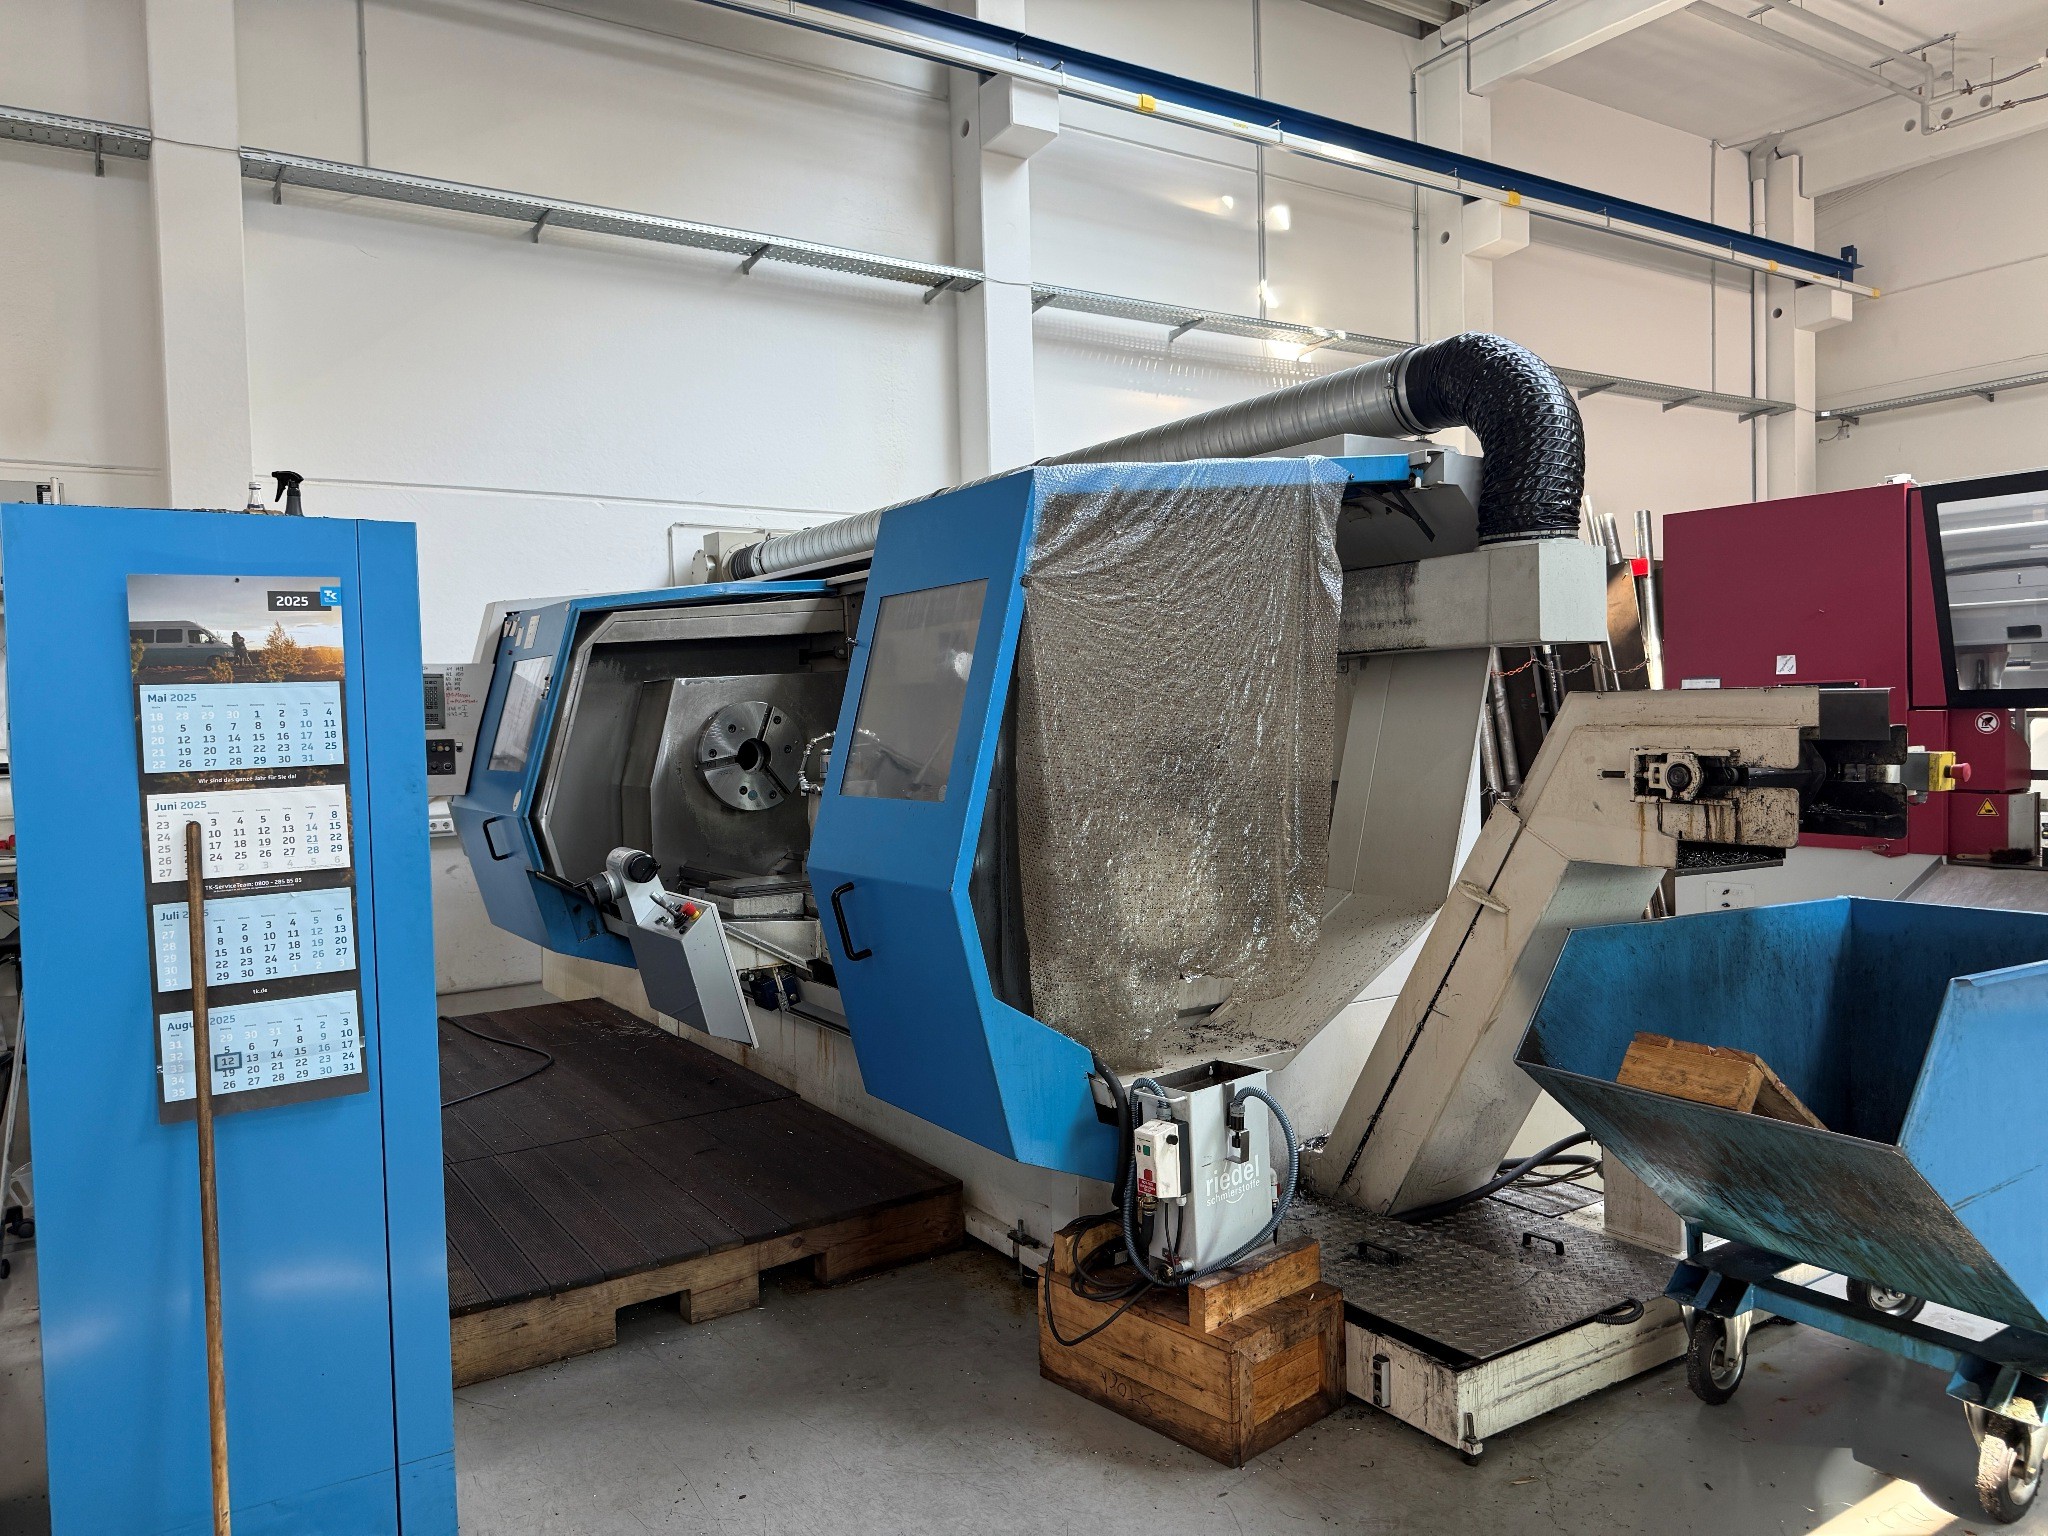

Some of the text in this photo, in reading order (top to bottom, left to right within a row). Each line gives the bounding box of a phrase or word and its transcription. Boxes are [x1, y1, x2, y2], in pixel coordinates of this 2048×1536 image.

[276, 596, 308, 607] 2025
[148, 694, 166, 702] Mai
[178, 736, 190, 744] 12
[203, 735, 215, 743] 13
[228, 734, 240, 742] 14
[154, 801, 206, 811] Juni 2025
[308, 812, 313, 820] 7
[209, 830, 221, 838] 10
[282, 825, 294, 833] 13
[330, 822, 341, 830] 15
[158, 845, 171, 853] 25
[259, 838, 271, 846] 19
[159, 857, 171, 865] 26
[308, 846, 319, 854] 28
[160, 869, 172, 877] 27
[160, 911, 179, 921] Juli
[264, 932, 275, 940] 10
[335, 925, 346, 933] 13
[215, 936, 347, 957] 15 16 17 18 19 20
[216, 961, 228, 969] 22
[241, 958, 252, 966] 23
[265, 955, 277, 963] 24
[289, 952, 300, 960] 25
[313, 950, 324, 958] 26
[217, 972, 229, 980] 29
[241, 969, 254, 977] 30
[210, 1015, 235, 1025] 2025
[225, 1046, 230, 1054] 5
[341, 1029, 352, 1037] 10
[222, 1040, 353, 1066] 12 13 14 15 16 17
[248, 1066, 259, 1074] 20
[271, 1062, 283, 1070] 21
[295, 1058, 307, 1067] 22
[319, 1055, 330, 1063] 23
[343, 1052, 354, 1060] 24
[224, 1063, 355, 1089] 26 27 28 29 30 31
[1206, 1154, 1259, 1196] riedel
[1207, 1179, 1260, 1206] schmierstoffe
